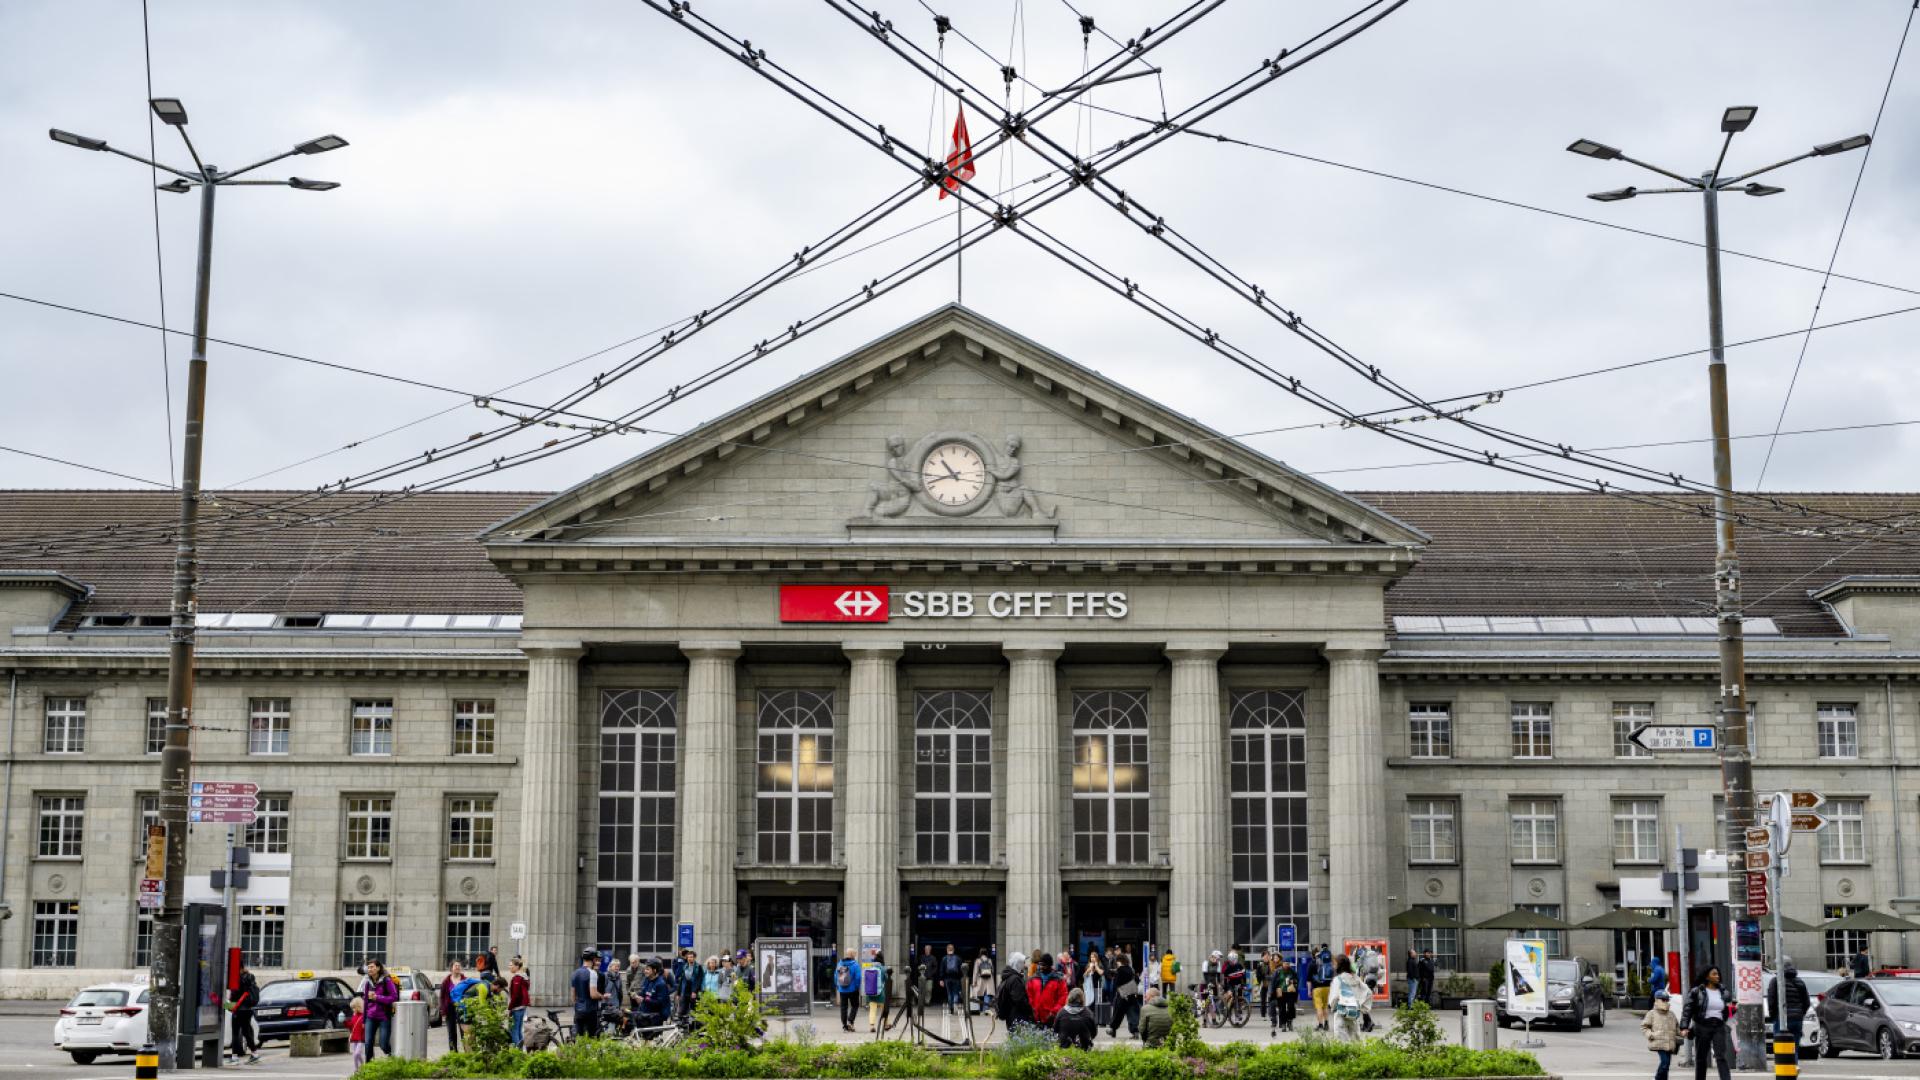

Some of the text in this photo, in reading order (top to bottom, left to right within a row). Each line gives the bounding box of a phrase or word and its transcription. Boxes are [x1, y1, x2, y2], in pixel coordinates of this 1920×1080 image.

[904, 591, 1129, 619] SBB CFF FFS
[1698, 732, 1707, 745] P
